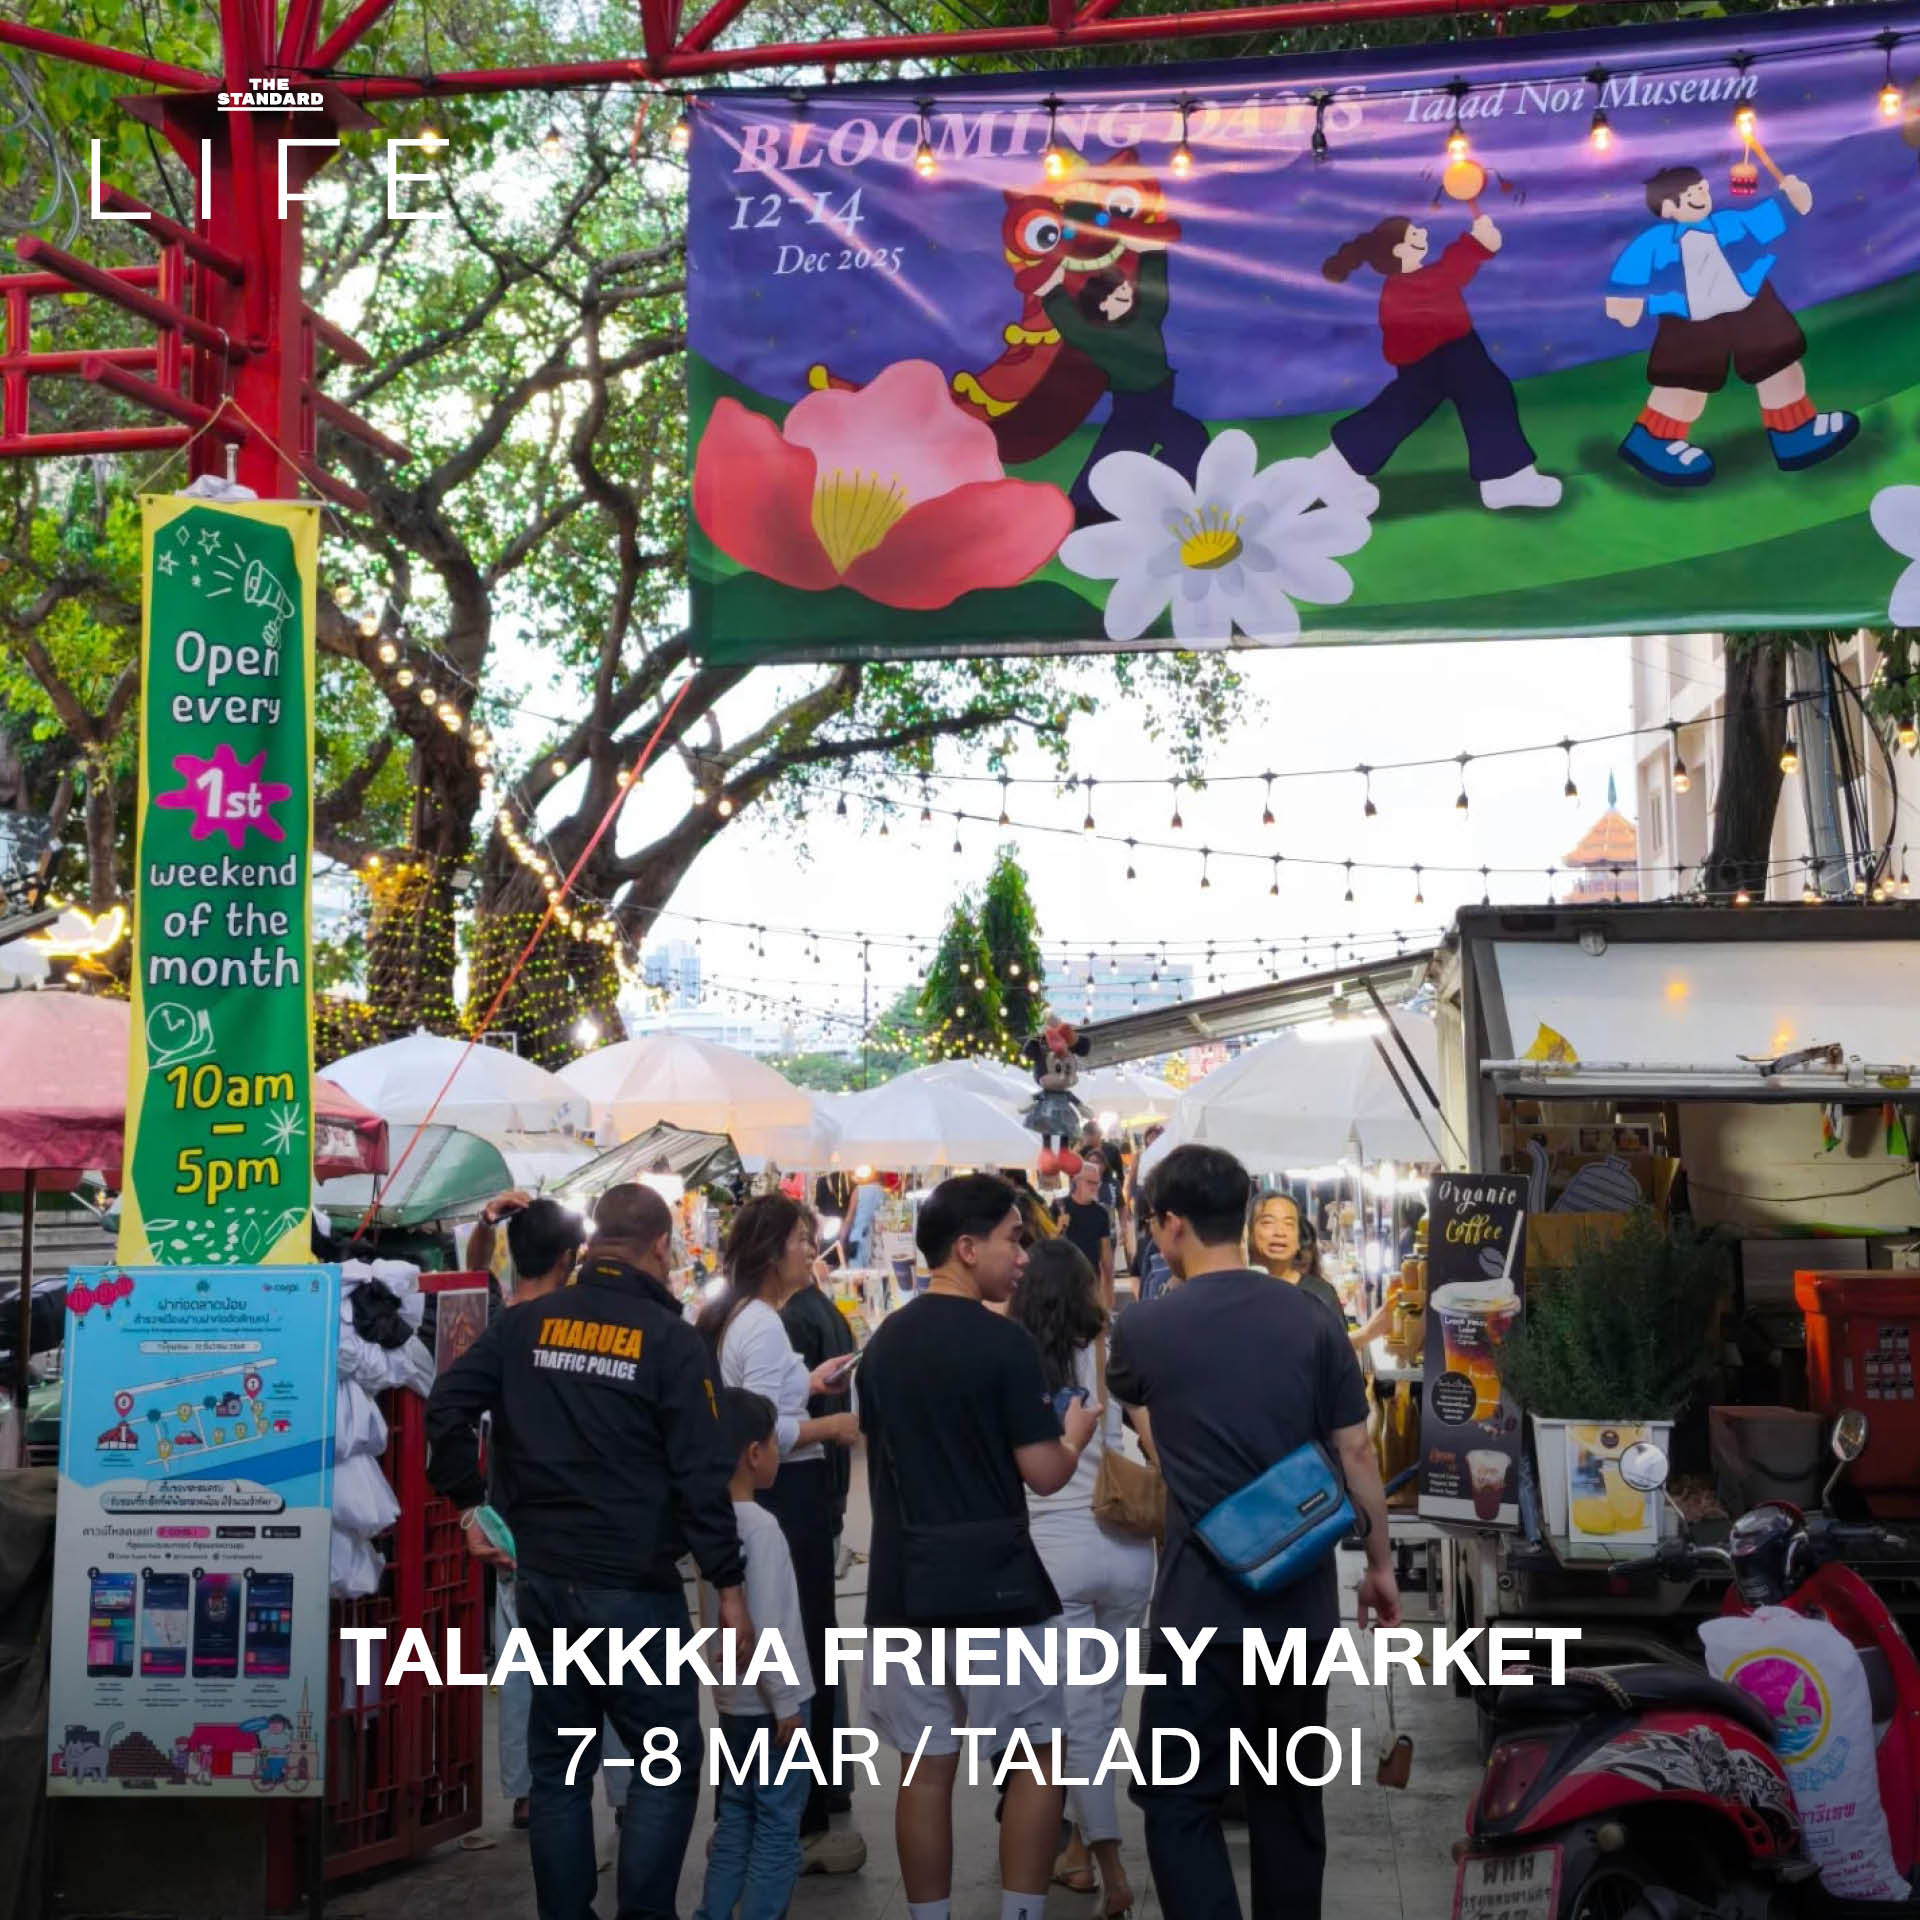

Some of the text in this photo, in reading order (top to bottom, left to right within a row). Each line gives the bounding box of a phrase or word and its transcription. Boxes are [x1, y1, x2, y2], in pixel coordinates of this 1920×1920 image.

[1512, 77, 1586, 115] Noi
[1594, 74, 1759, 109] Museum
[732, 92, 1366, 174] BLOOMING DAYS
[729, 187, 866, 236] 12-14
[773, 243, 906, 276] Dec 2025
[175, 631, 280, 687] Open
[172, 694, 281, 725] every
[195, 766, 264, 819] 1st
[150, 855, 297, 888] weekend
[165, 903, 290, 938] of the
[149, 947, 300, 988] month
[166, 1064, 295, 1109] 10am
[175, 1147, 281, 1206] 5pm
[1439, 1179, 1518, 1215] Organic
[1445, 1214, 1504, 1246] Coffee
[539, 1317, 643, 1359] THARUEA
[532, 1349, 638, 1381] TRAFFIC POLICE
